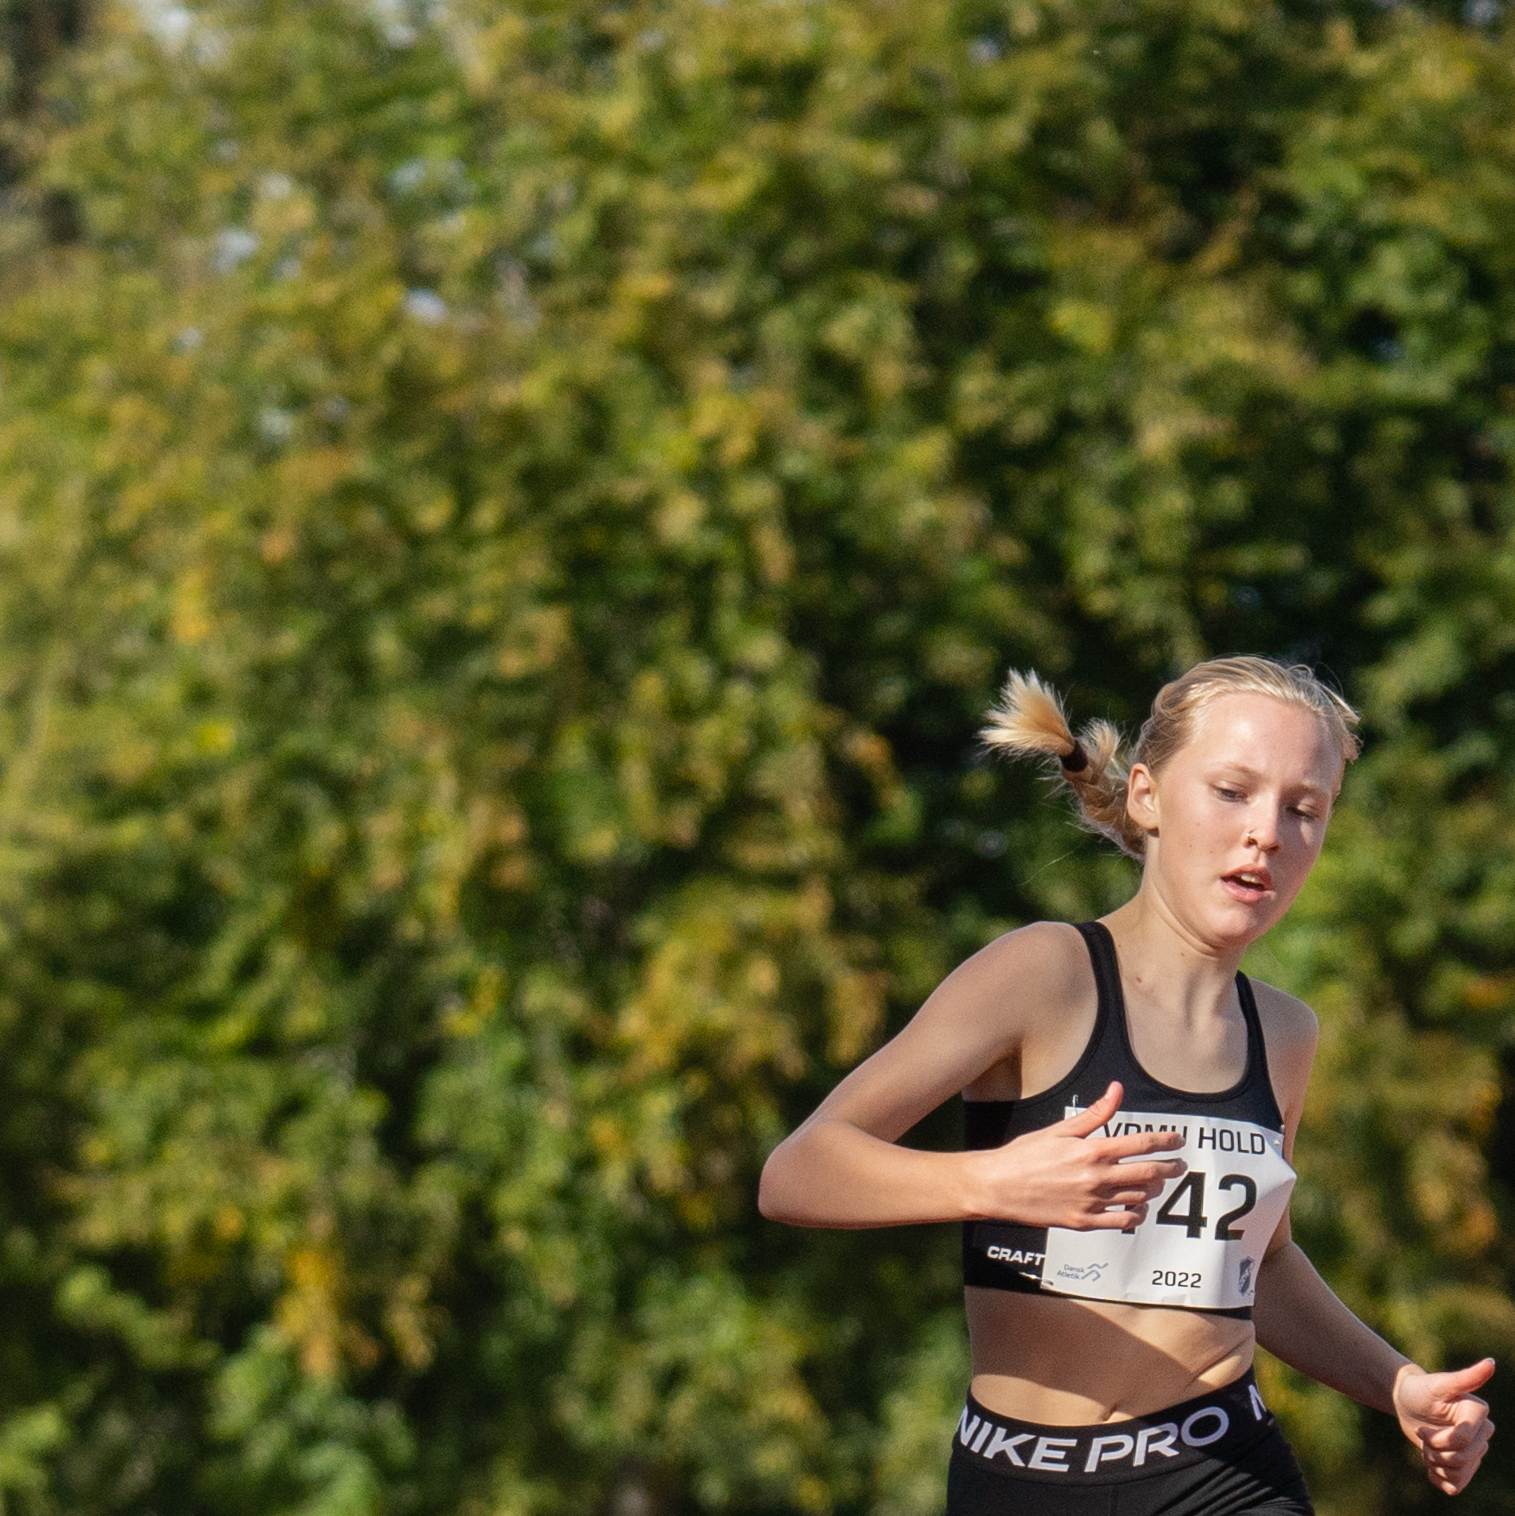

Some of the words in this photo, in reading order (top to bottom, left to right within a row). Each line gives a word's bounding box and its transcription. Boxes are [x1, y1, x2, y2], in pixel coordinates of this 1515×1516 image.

[1198, 1127, 1265, 1155] HOLD
[1121, 1171, 1257, 1240] 42
[987, 1245, 1045, 1266] CRAFT
[1152, 1270, 1201, 1288] 2022
[956, 1404, 1078, 1472] NIKE
[1084, 1406, 1229, 1473] PRO
